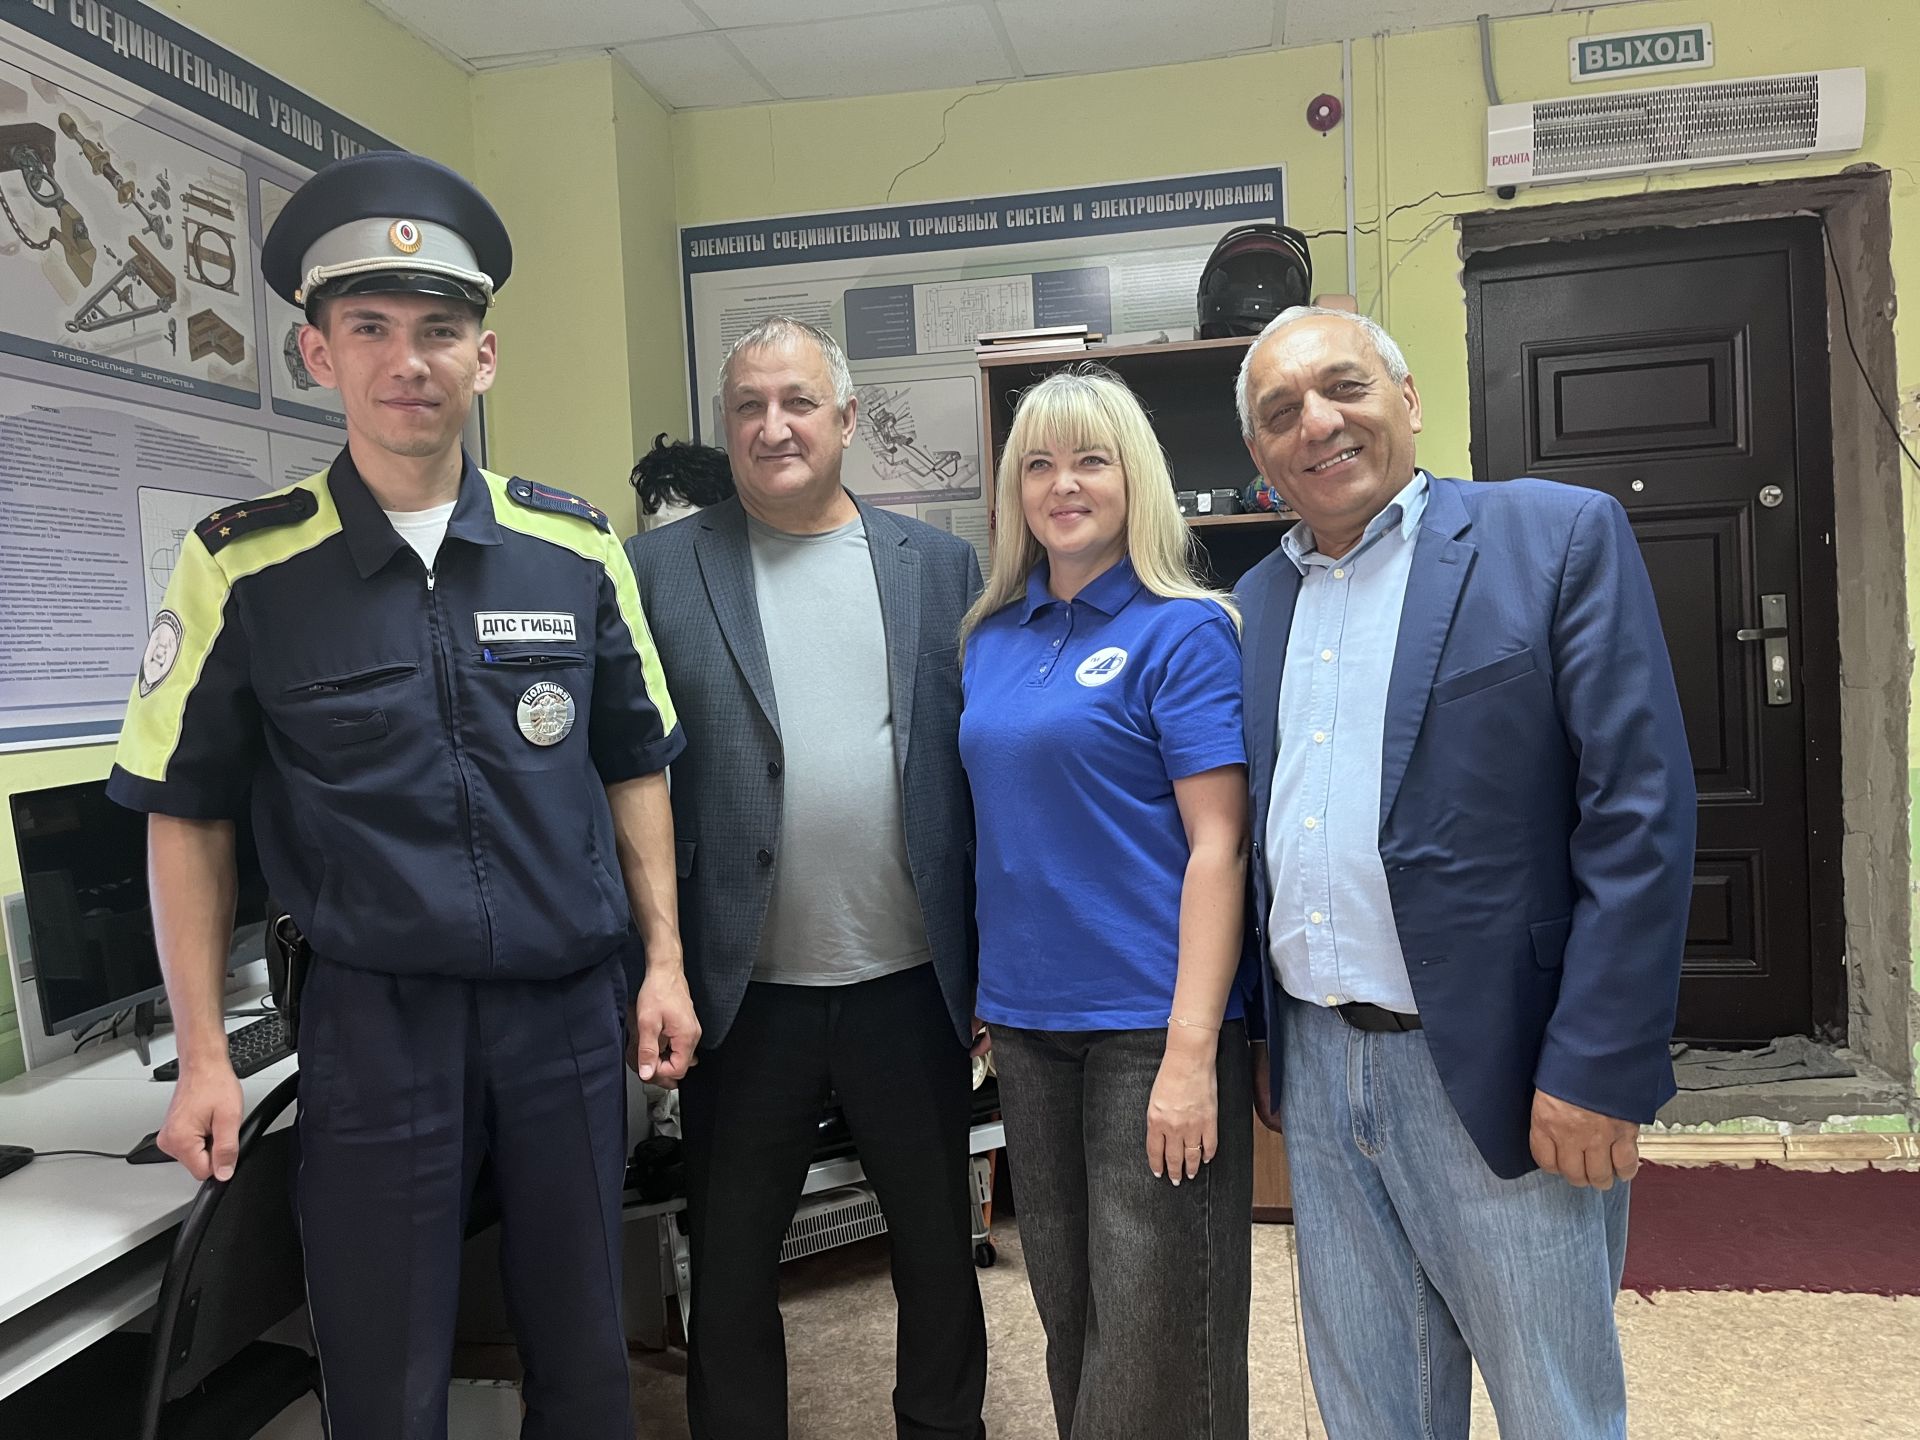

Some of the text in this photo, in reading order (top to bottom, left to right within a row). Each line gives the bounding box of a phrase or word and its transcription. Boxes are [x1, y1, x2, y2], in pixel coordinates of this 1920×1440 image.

[1584, 34, 1699, 71] ВЫХОД
[70, 0, 260, 119] СОЕДИНИТЕЛЬНЫХ
[268, 95, 323, 152] УЗЛОВ
[1492, 152, 1530, 167] РЕСАНТА
[690, 183, 1274, 258] ЭЛЕМЕНТЫ СОЕДИНИТЕЛЬНЫХ ТОРМОЗНЫХ СИСТЕМ И ЭЛЕКТРООБОРУДОВАНИЯ
[51, 349, 195, 389] ТЯГОВО-СЦЕПНЫЕ УСТРОЙСТВА
[482, 618, 574, 636] ДПС ГИБДД
[523, 683, 569, 704] ПОЛИЦИЯ
